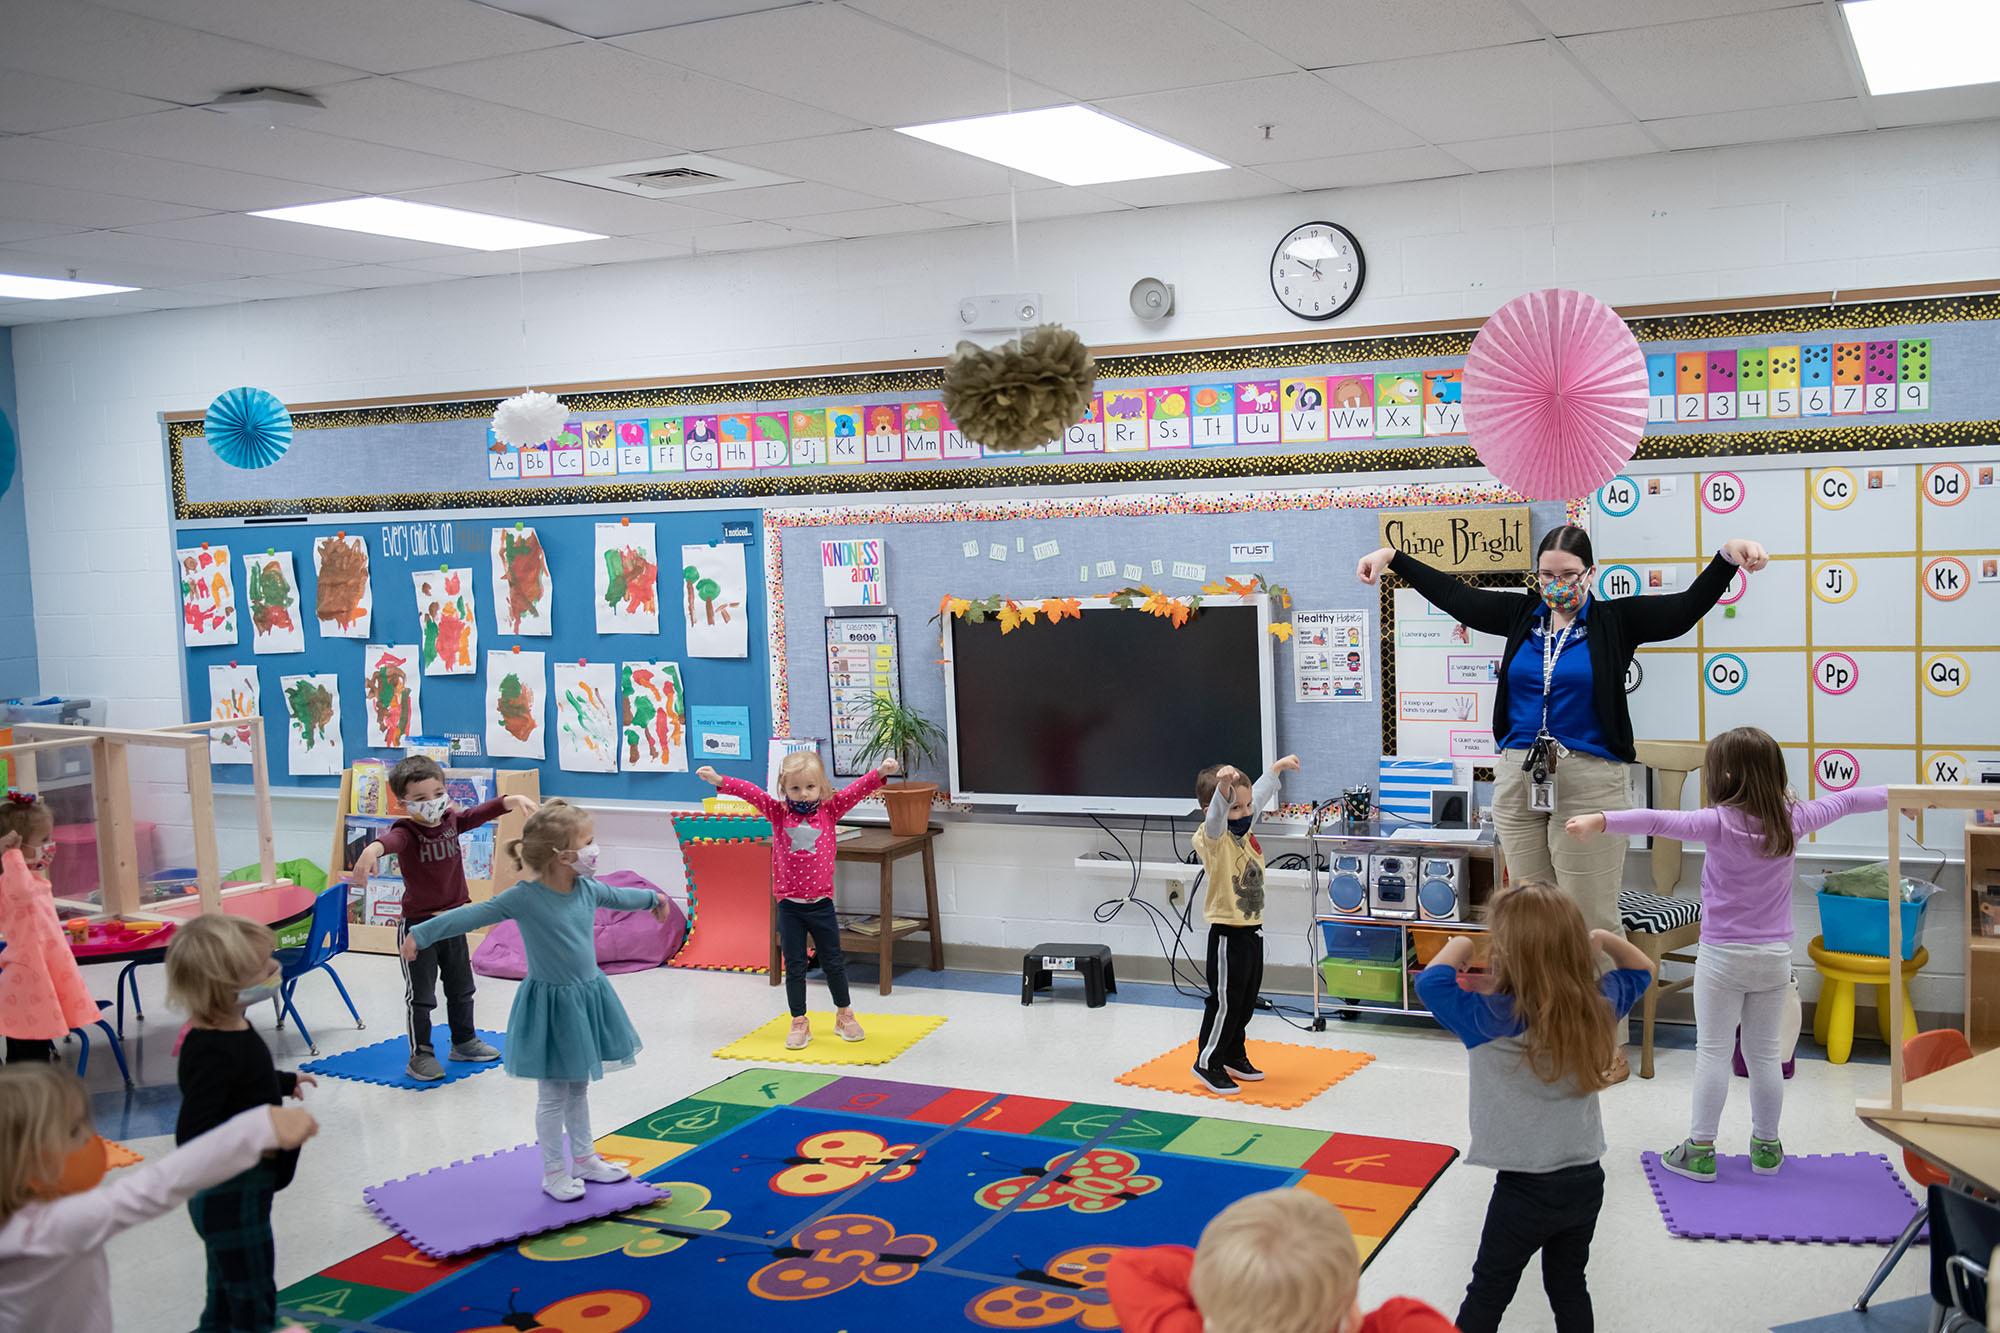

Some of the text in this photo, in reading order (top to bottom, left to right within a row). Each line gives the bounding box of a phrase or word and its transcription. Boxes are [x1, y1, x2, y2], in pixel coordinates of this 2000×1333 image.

[1342, 245, 1347, 255] 2
[1279, 269, 1285, 278] 9
[1347, 263, 1352, 272] 3
[1284, 286, 1290, 296] 8
[1343, 281, 1348, 290] 4
[1297, 298, 1302, 308] 7
[1314, 301, 1320, 312] 6
[1331, 295, 1337, 305] 5
[1685, 397, 1699, 418] 2
[1716, 395, 1729, 416] 3
[1746, 393, 1761, 414] 4
[1777, 392, 1791, 412] 5
[1809, 390, 1824, 410] 6
[1844, 388, 1859, 409] 7
[1873, 387, 1888, 408] 8
[1907, 386, 1921, 406] 9
[1068, 425, 1099, 451] Qq
[1116, 423, 1135, 441] Rr
[1159, 420, 1178, 439] Ss
[1203, 418, 1221, 436] Tt
[1245, 415, 1270, 434] Uu
[1290, 413, 1317, 432] Vv
[1332, 410, 1370, 429] Ww
[1385, 408, 1411, 427] Xx
[1435, 405, 1460, 432] Yy
[494, 455, 514, 471] Aa
[526, 453, 544, 469] Bb
[558, 452, 576, 467] Cc
[590, 451, 609, 467] Dd
[624, 449, 641, 465] Ee
[660, 448, 674, 463] Ff
[690, 446, 713, 468] Gg
[726, 444, 746, 460] Hh
[766, 443, 777, 459] Ii
[801, 440, 816, 464] Jj
[835, 438, 855, 455] Kk
[875, 437, 891, 453] Ll
[907, 435, 937, 452] Mm
[1607, 485, 1629, 504] Aa
[1712, 483, 1735, 502] Bb
[1822, 478, 1848, 498] Cc
[1933, 475, 1959, 495] Dd
[382, 524, 409, 561] Every
[430, 522, 439, 555] is
[1448, 518, 1523, 566] Bright
[822, 541, 879, 567] KINDNESS
[851, 563, 880, 582] above
[1825, 569, 1843, 594] Jj
[1934, 567, 1959, 590] Kk
[862, 583, 882, 605] ALL
[1611, 575, 1630, 594] Hh
[1297, 613, 1335, 624] Healthy
[1712, 663, 1740, 684] Oo
[1825, 663, 1849, 688] Pp
[1930, 662, 1960, 686] Qq
[1823, 760, 1853, 780] Ww
[1935, 762, 1958, 782] Xx
[420, 839, 460, 864] HUN
[281, 934, 297, 945] Big
[757, 1081, 781, 1100] f
[1220, 1133, 1263, 1157] j
[823, 1154, 879, 1169] 4
[1055, 1176, 1126, 1201] 10
[813, 1247, 877, 1267] 5
